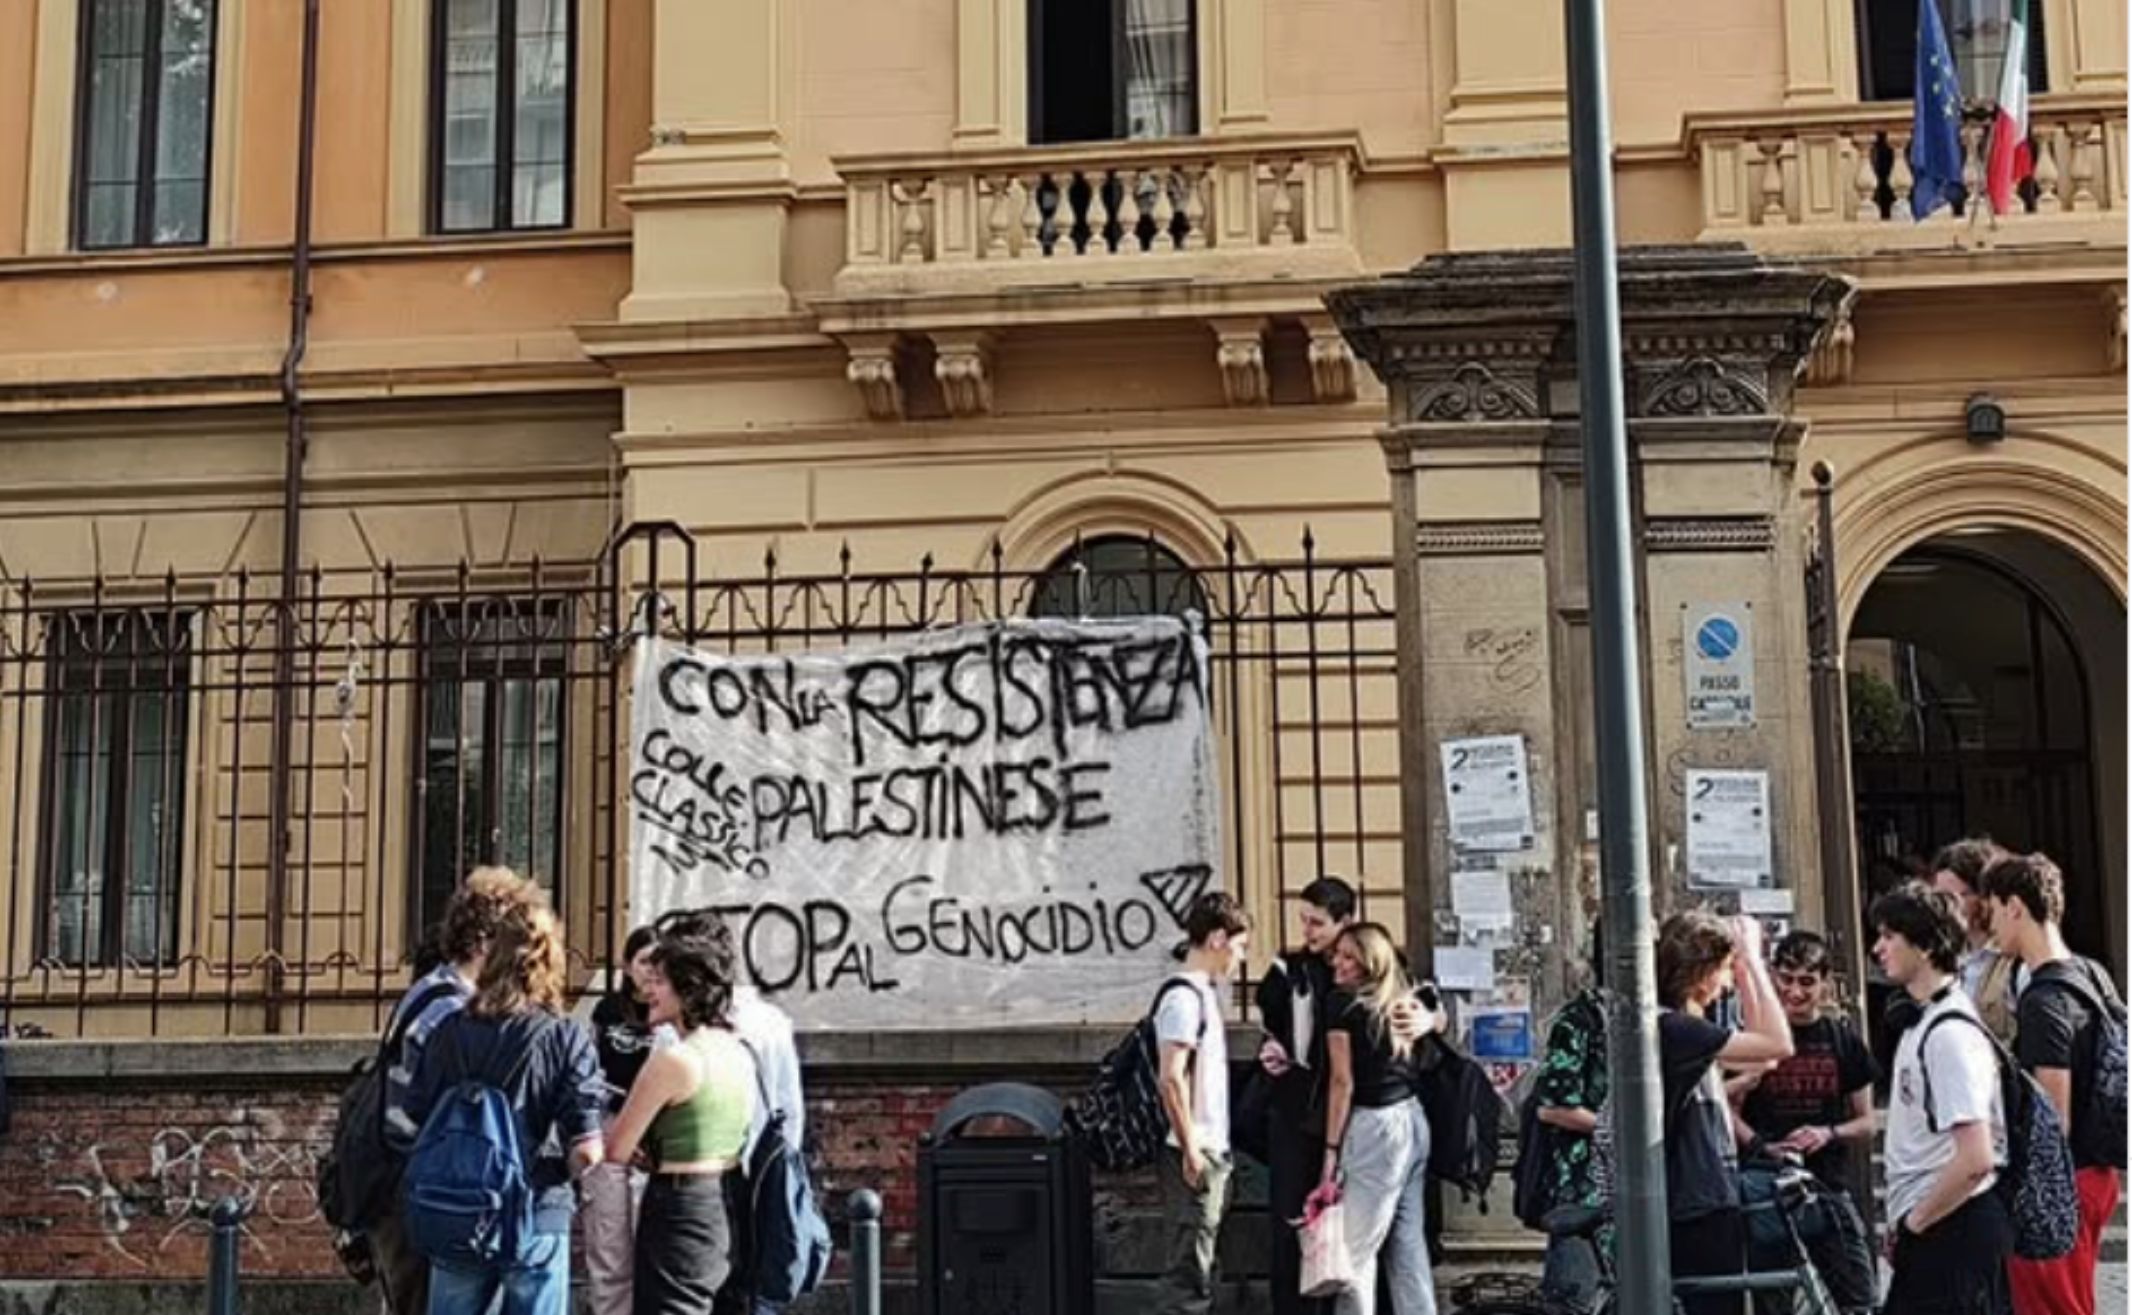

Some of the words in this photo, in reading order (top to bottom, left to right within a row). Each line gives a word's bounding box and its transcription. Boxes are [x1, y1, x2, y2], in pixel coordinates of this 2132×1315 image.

[1700, 675, 1740, 690] PASSO
[658, 657, 800, 735] CON
[797, 686, 836, 726] LA
[845, 631, 1204, 767] RESISTENZA
[1450, 747, 1468, 770] 2
[1694, 778, 1714, 799] 2
[655, 899, 850, 993] OP
[825, 942, 900, 993] AL
[881, 875, 1156, 963] GENOCIDIO
